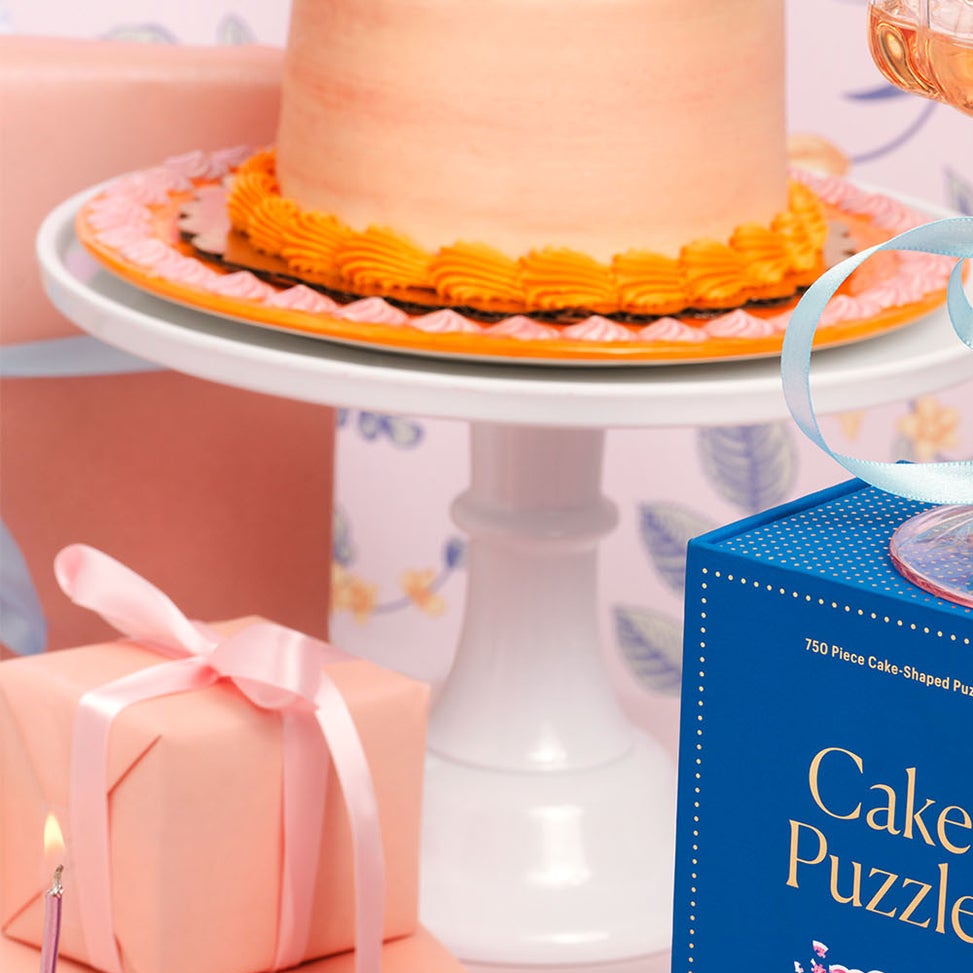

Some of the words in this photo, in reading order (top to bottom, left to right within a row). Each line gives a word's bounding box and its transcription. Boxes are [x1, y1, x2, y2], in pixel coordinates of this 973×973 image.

[805, 638, 828, 655] 750
[831, 645, 865, 666] Piece
[868, 656, 950, 690] Cake-Shaped
[809, 747, 973, 855] Cake
